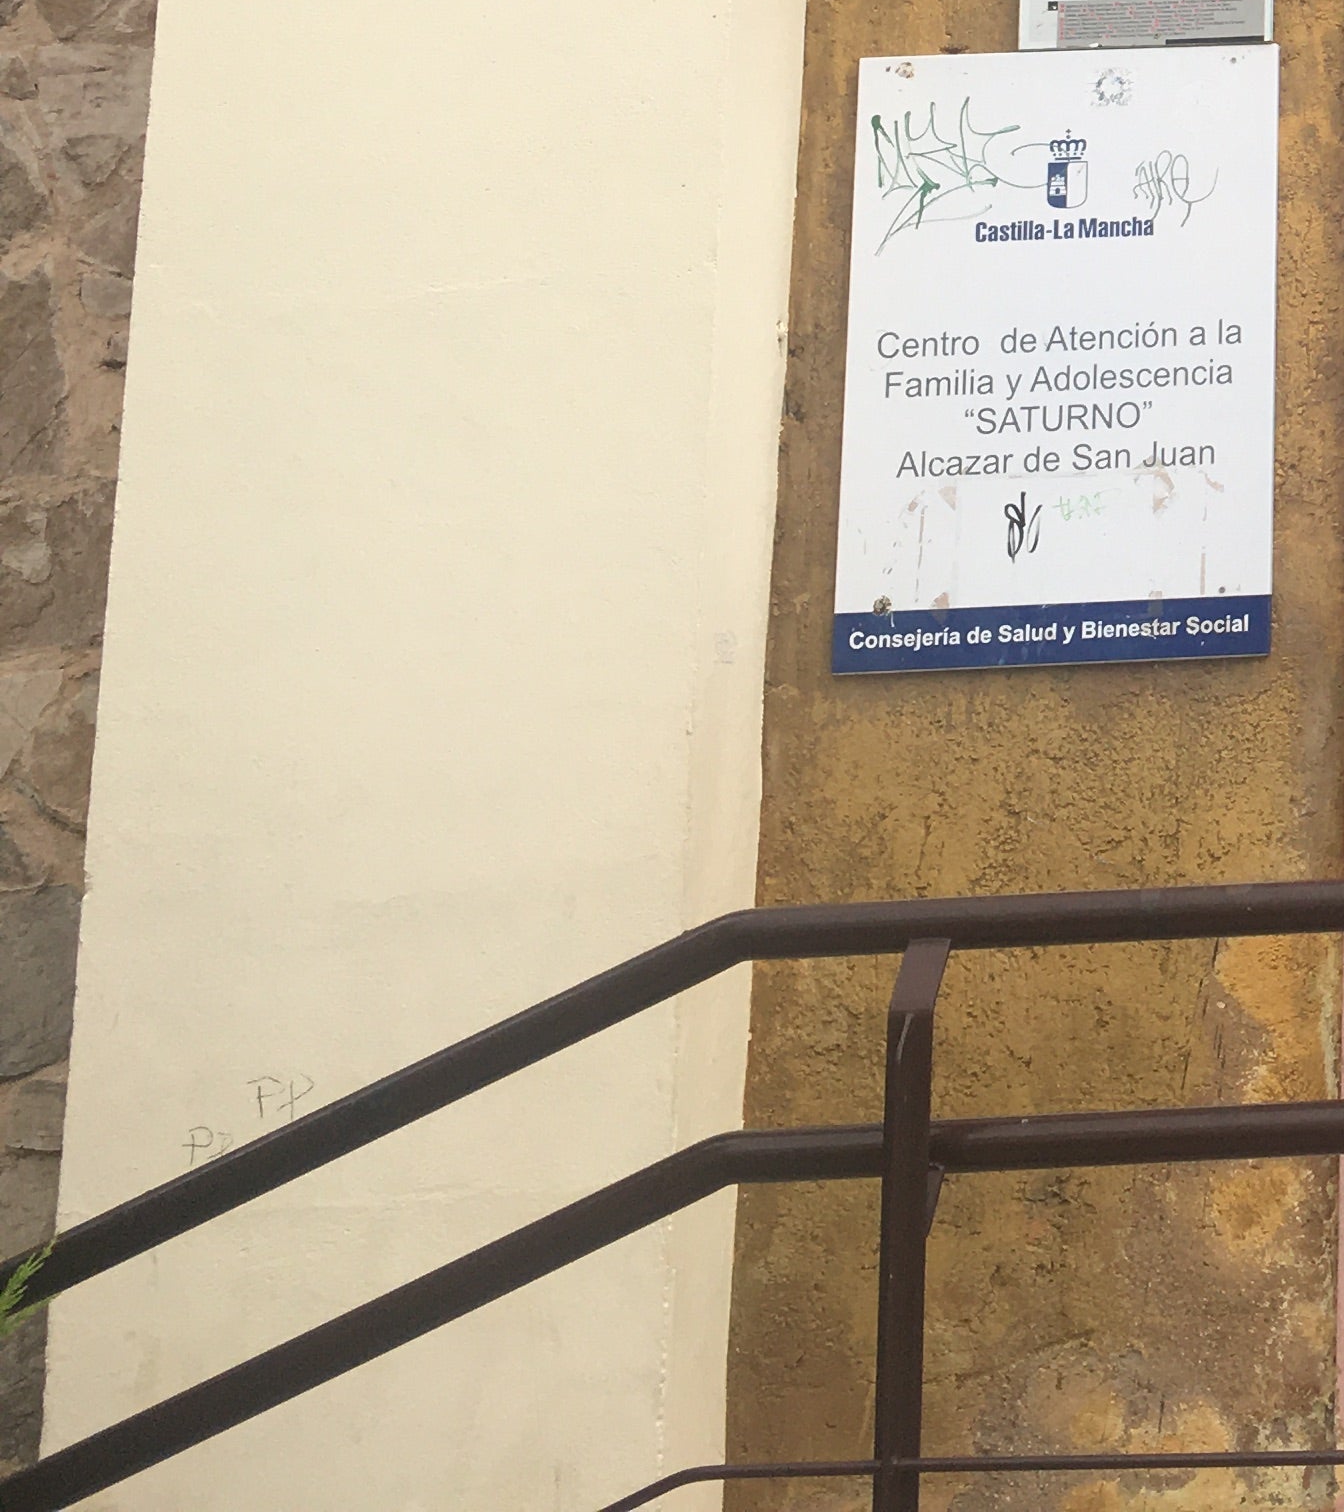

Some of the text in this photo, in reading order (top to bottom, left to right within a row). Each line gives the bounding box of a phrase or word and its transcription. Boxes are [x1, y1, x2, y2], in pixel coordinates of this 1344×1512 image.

[975, 217, 1154, 243] Castilla-La Mancha
[877, 318, 1244, 360] Centro de Atención a la
[885, 357, 1234, 400] Familia y Adolescencia
[896, 438, 1217, 479] Alcazar de San Juan
[848, 613, 1250, 651] Consejería de Salud y Bienestar Social
